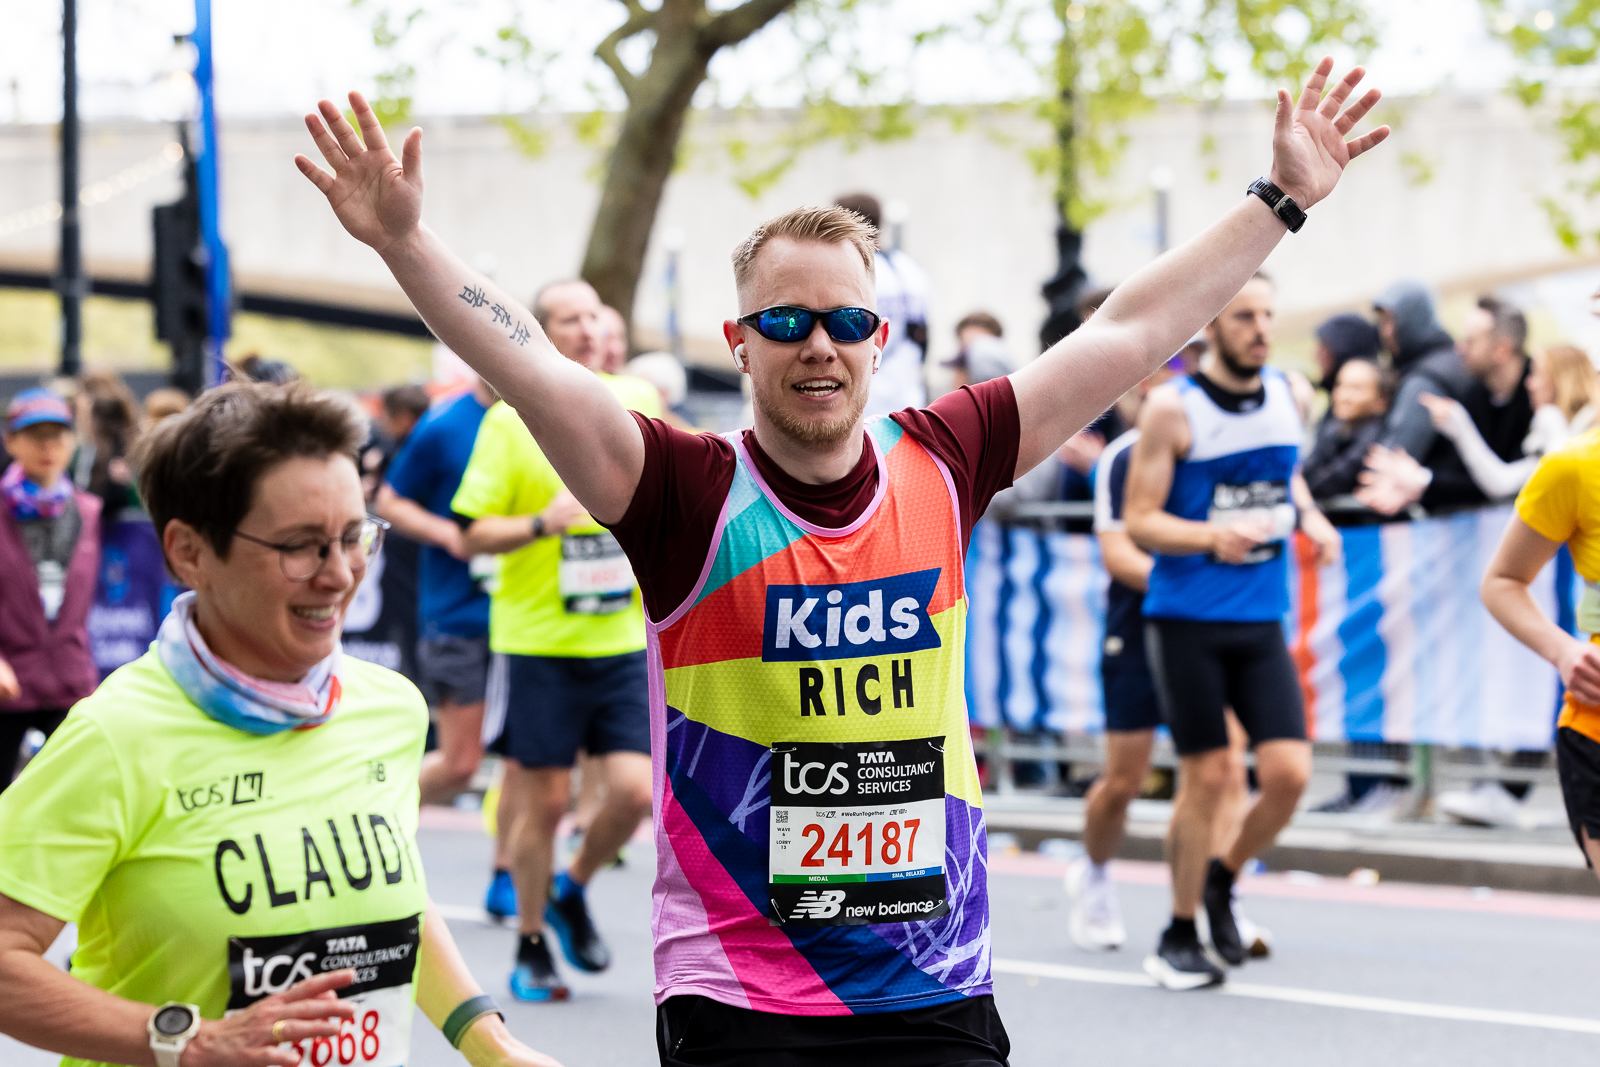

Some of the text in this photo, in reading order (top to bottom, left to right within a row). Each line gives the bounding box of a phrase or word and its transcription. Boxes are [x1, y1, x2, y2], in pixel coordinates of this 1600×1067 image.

[458, 284, 531, 347] 生存者
[775, 589, 920, 649] Kids
[799, 659, 914, 717] RICH
[857, 751, 896, 764] TATA
[784, 752, 849, 795] tcs
[857, 761, 936, 780] CONSULTANCY
[857, 779, 911, 795] SERVICES
[800, 818, 920, 867] 24187
[905, 869, 926, 877] RELAXED
[845, 900, 935, 918] new balance
[326, 935, 368, 953] TATA
[320, 943, 413, 970] CONSULTANCY
